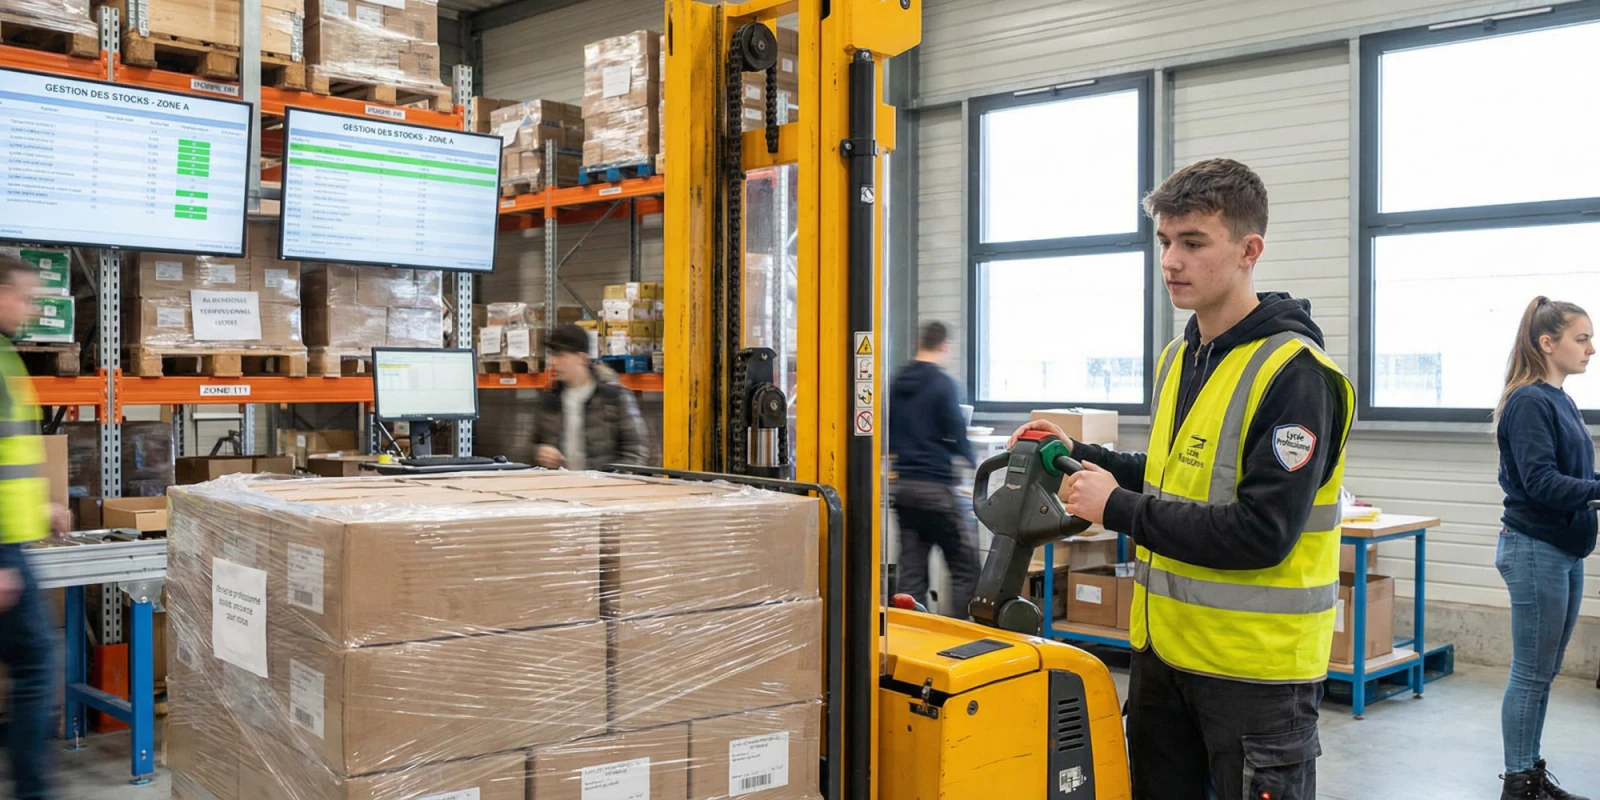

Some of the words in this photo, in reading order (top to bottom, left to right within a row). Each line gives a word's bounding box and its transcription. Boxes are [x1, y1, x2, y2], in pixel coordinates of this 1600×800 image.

[45, 83, 88, 96] GESTION
[90, 90, 109, 100] DES
[112, 93, 149, 105] STOCKS
[156, 99, 181, 110] ZONE
[183, 103, 189, 111] A
[343, 123, 376, 134] GESTION
[377, 128, 392, 137] DES
[394, 131, 423, 140] STOCKS
[428, 135, 447, 144] ZONE
